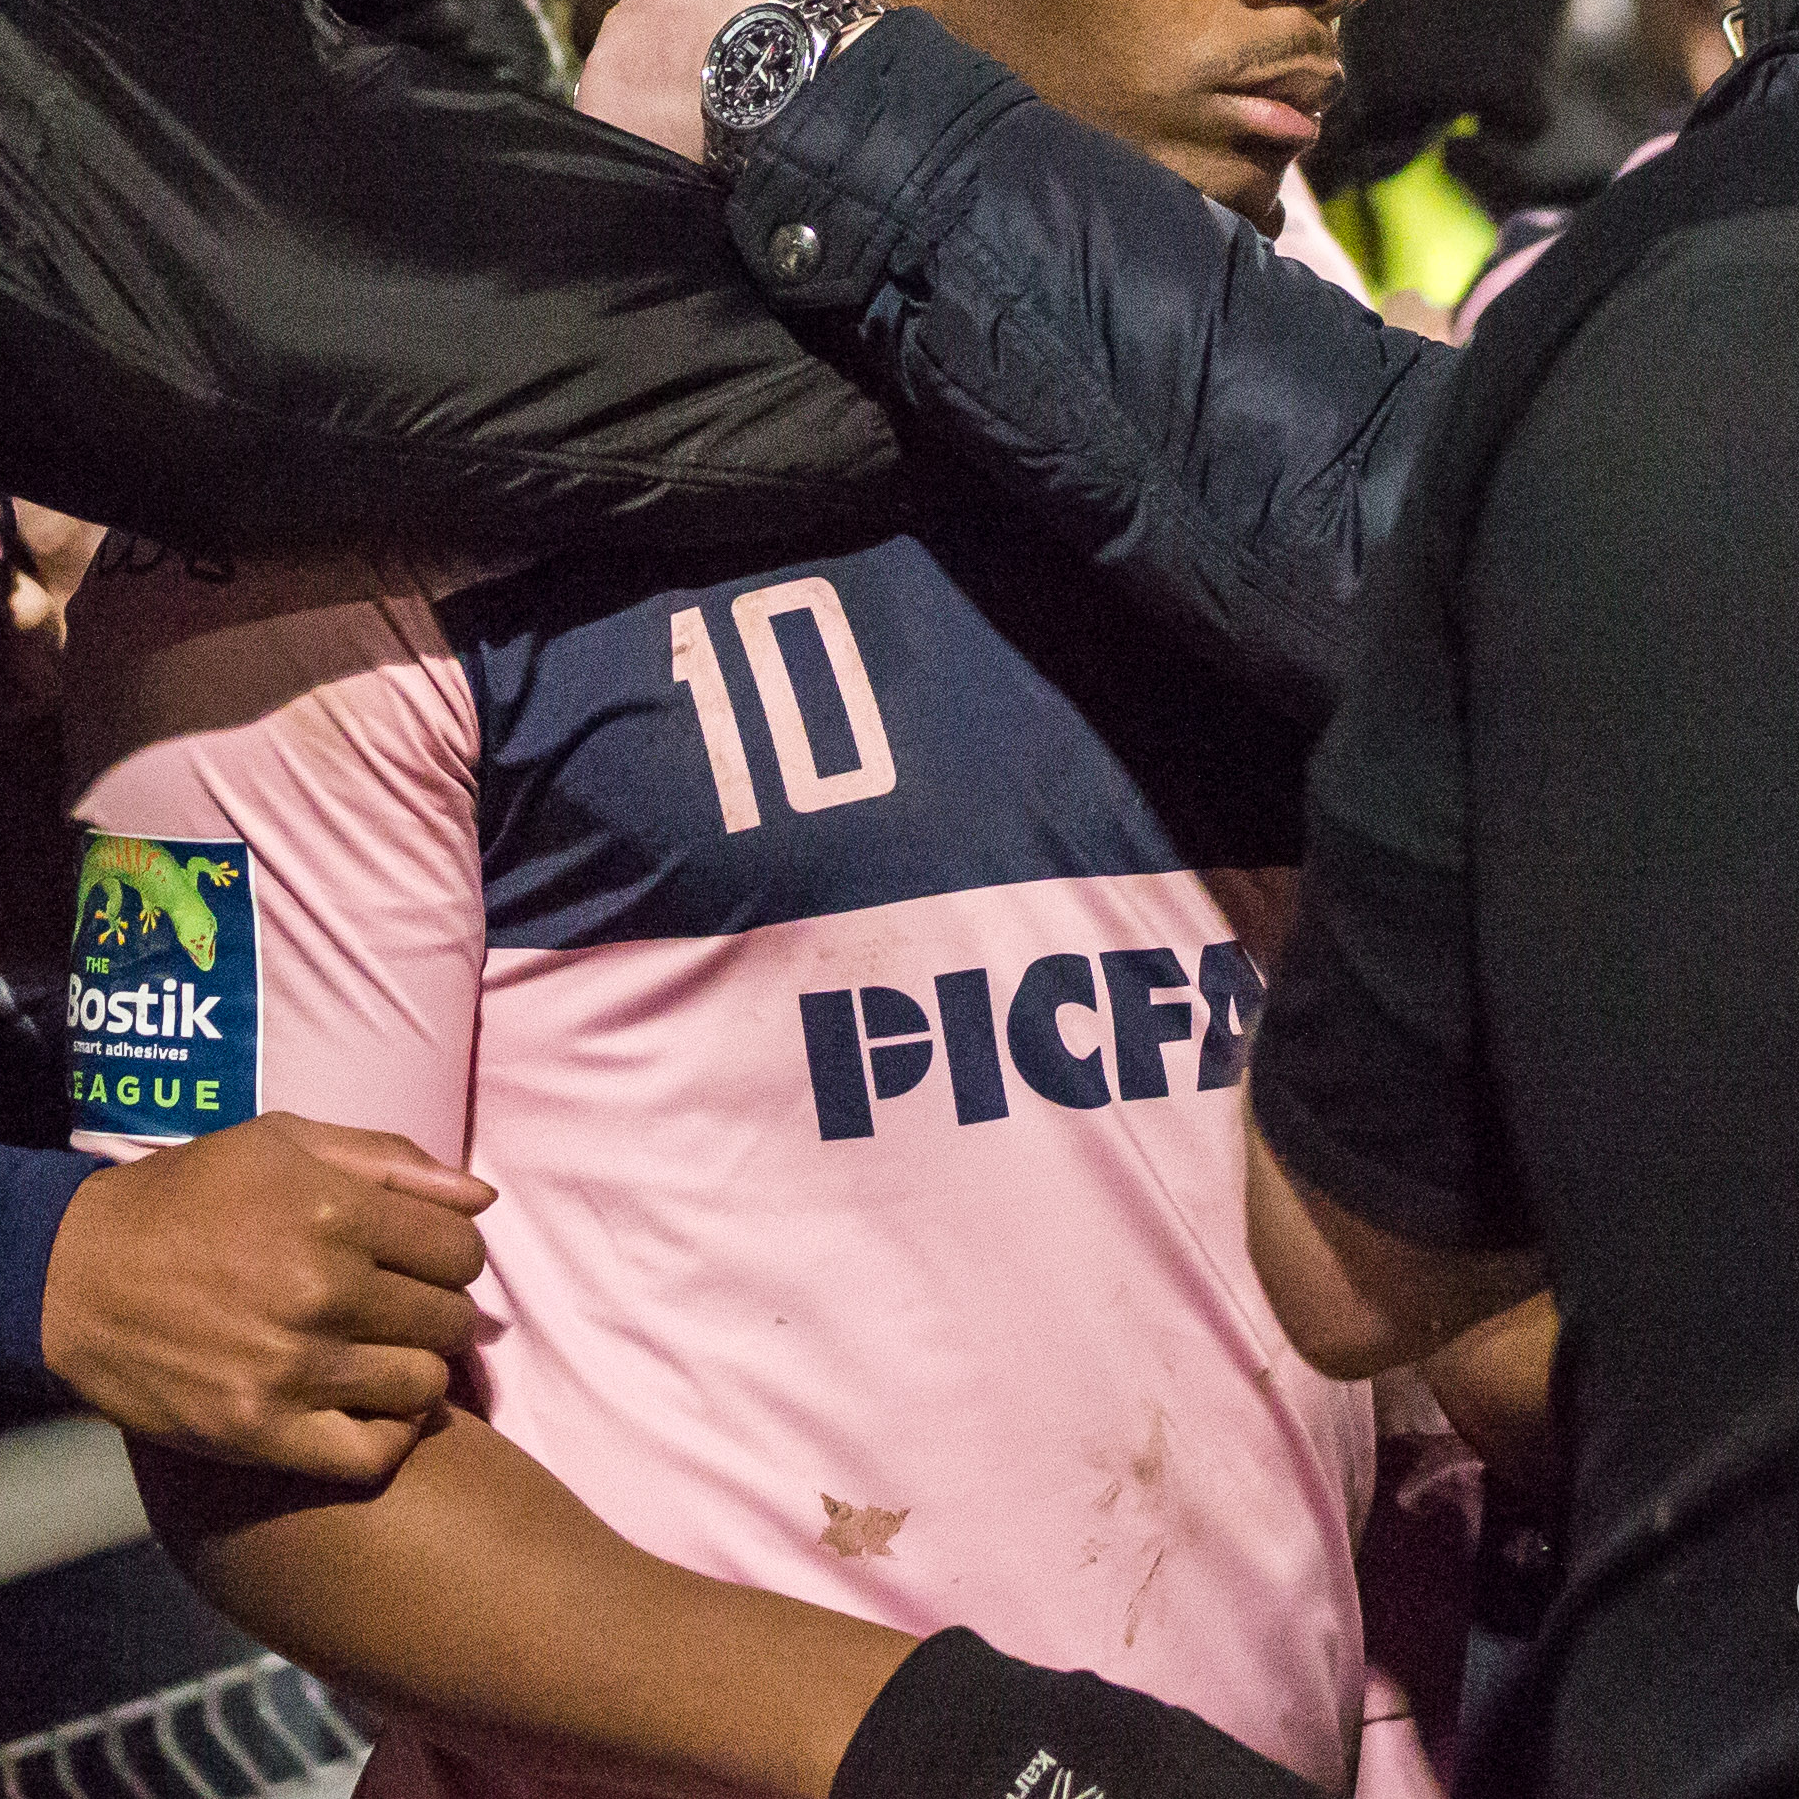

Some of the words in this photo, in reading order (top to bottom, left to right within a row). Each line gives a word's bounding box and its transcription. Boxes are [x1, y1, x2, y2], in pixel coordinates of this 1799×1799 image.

[671, 576, 897, 834] 10
[86, 956, 110, 974] THE
[67, 973, 222, 1039] Bostik
[105, 1042, 188, 1061] adhesives
[799, 940, 1263, 1141] PICFA
[68, 1071, 220, 1110] EAGUE
[1005, 1748, 1058, 1799] kar
